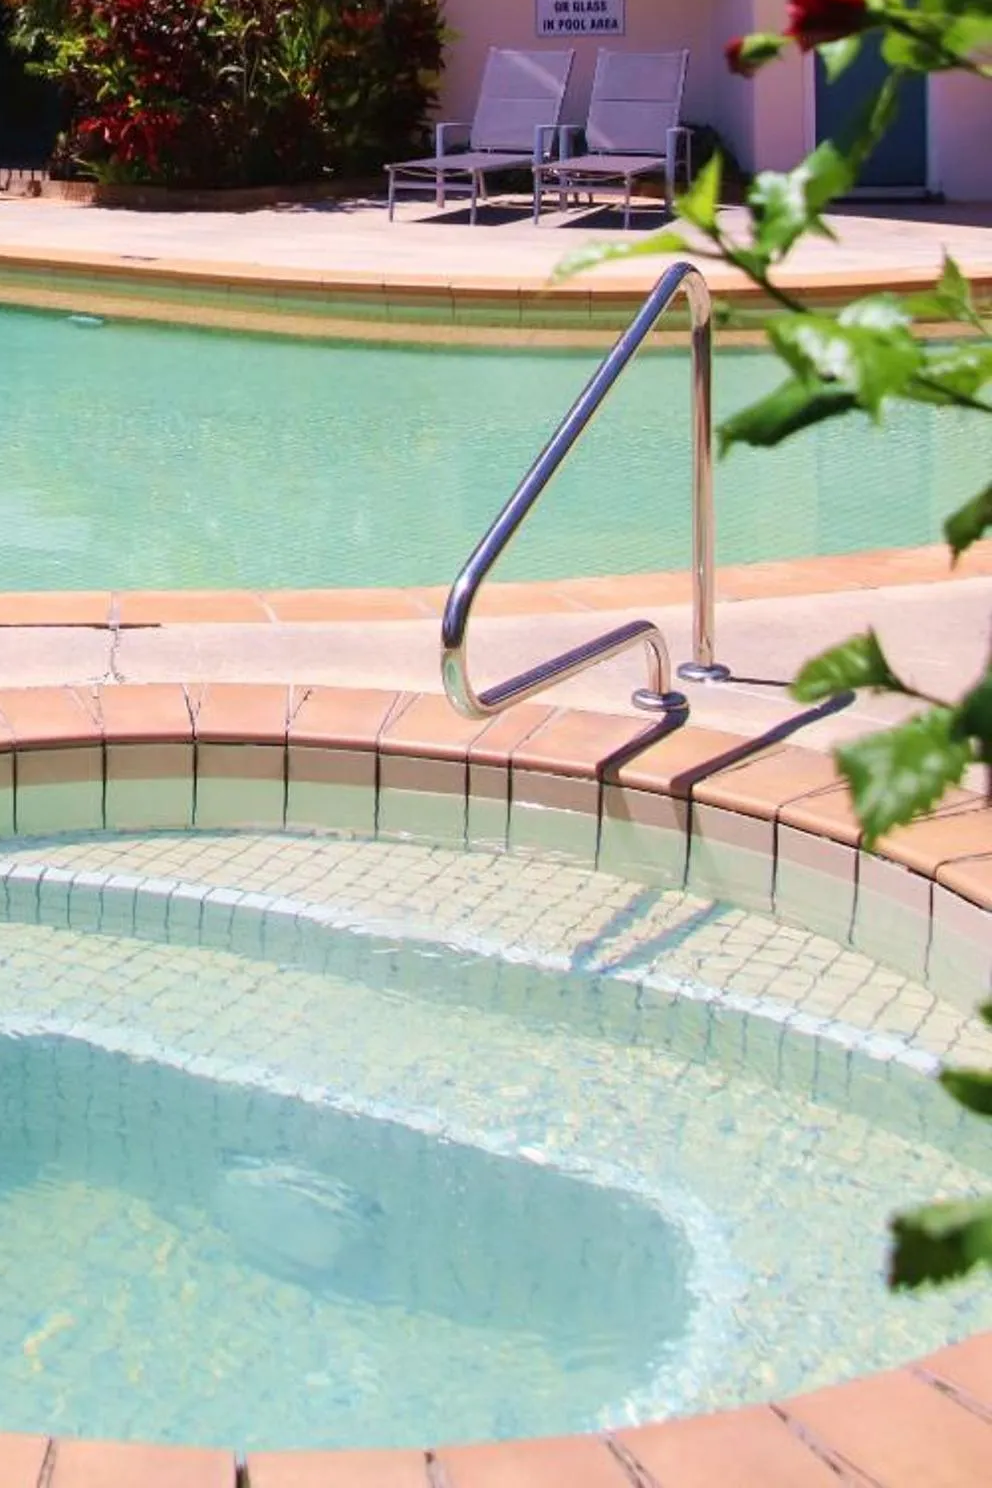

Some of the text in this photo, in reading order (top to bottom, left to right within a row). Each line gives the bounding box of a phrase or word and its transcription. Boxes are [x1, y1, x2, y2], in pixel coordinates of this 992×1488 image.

[554, 0, 607, 13] OR GLASS
[543, 18, 618, 31] IN POOL AREA
